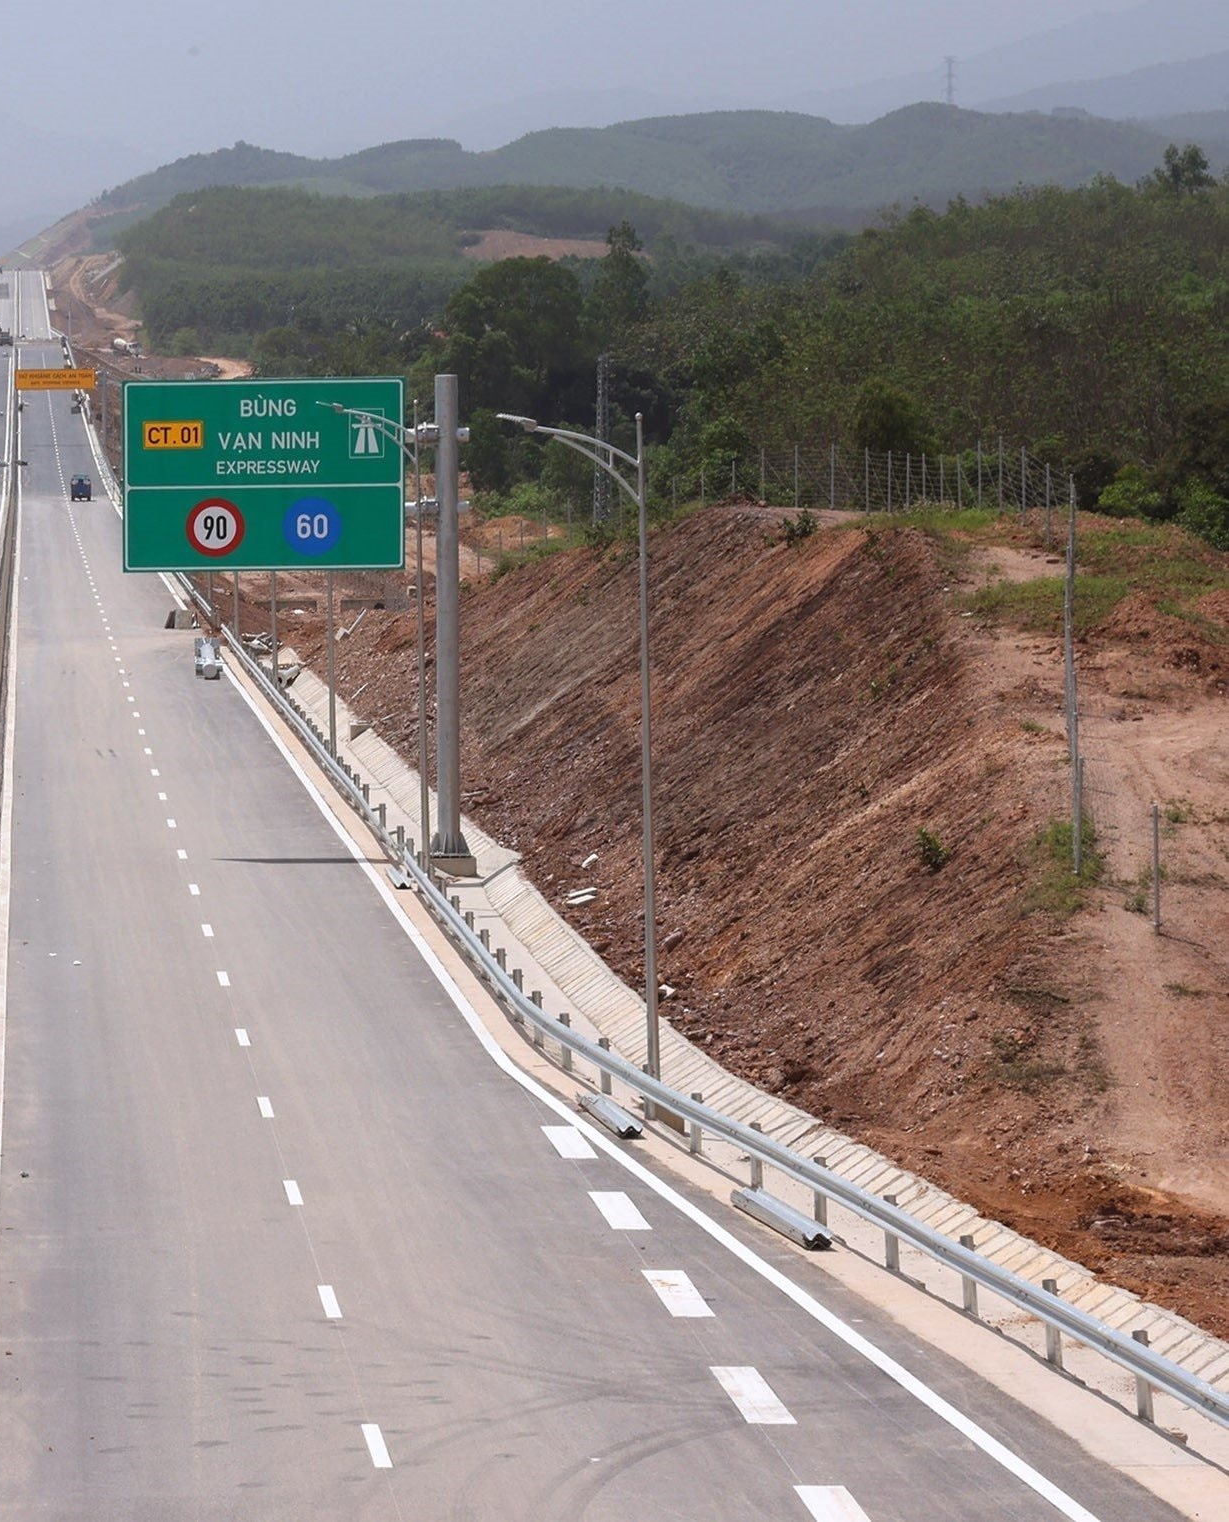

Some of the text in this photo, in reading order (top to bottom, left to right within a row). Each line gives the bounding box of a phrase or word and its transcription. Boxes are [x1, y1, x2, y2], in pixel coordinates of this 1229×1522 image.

[239, 394, 297, 418] BÙNG
[218, 431, 320, 453] VẠN NINH
[216, 460, 321, 475] EXPRESSWAY
[203, 515, 228, 541] 90
[296, 513, 329, 539] 60
